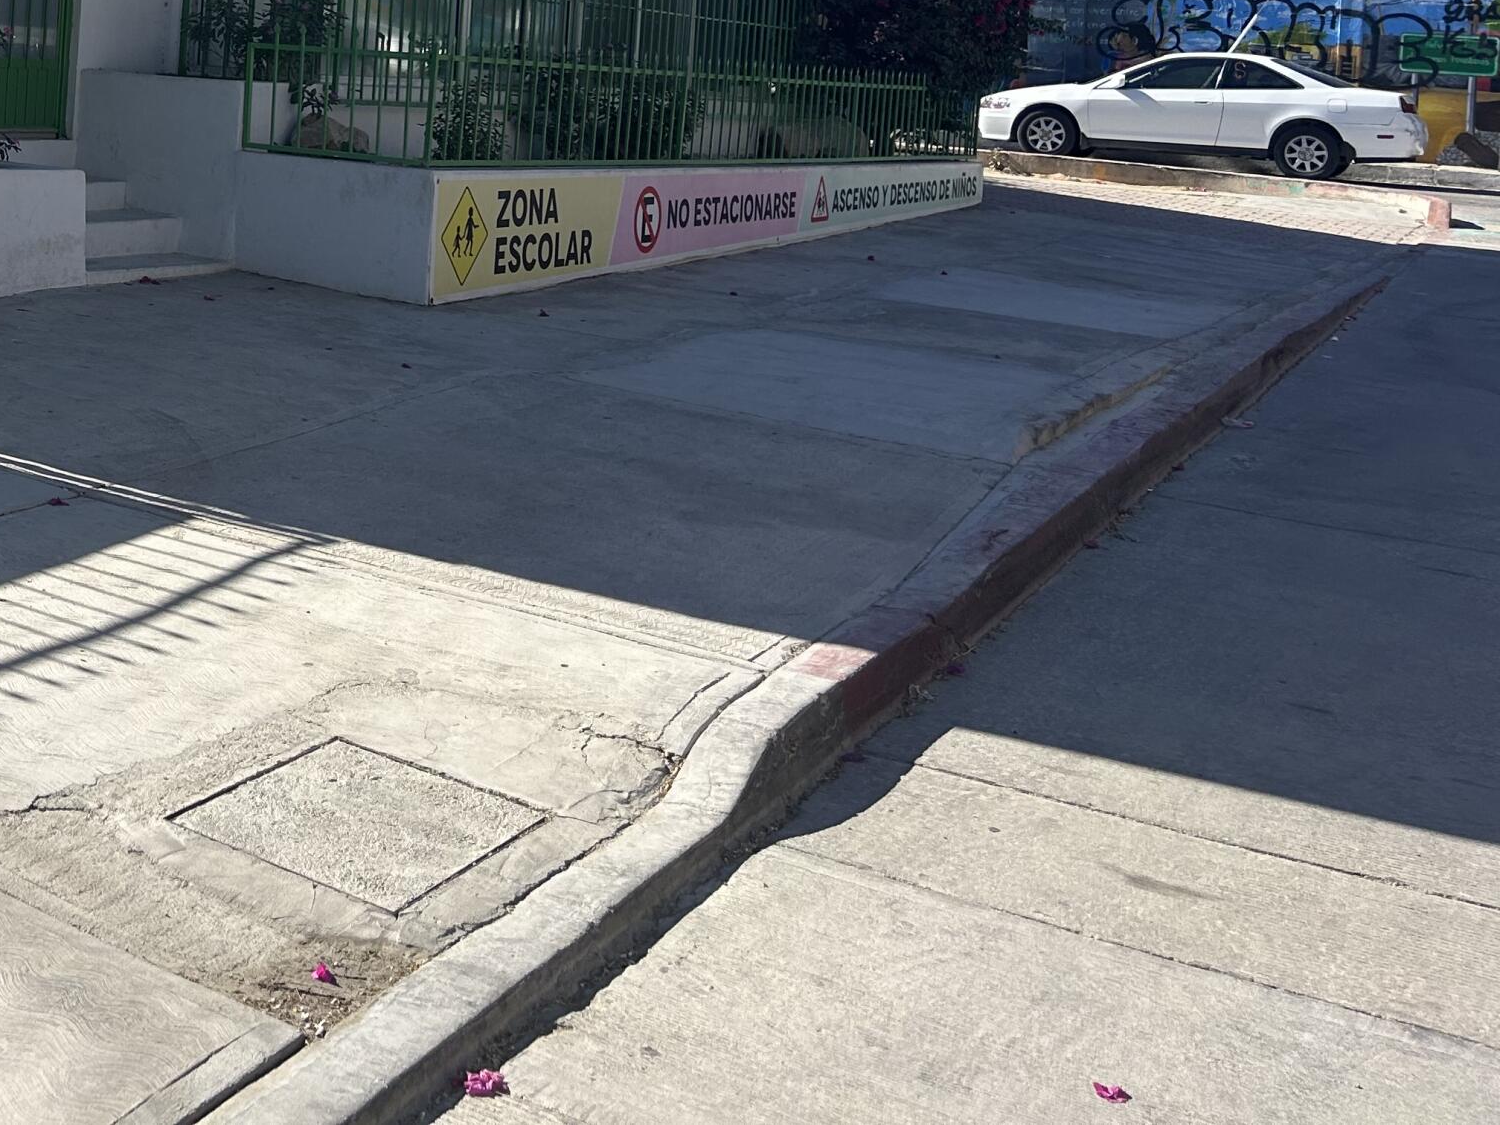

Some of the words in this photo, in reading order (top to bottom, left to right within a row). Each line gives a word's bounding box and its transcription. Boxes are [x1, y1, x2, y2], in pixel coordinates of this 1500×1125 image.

[496, 188, 559, 228] ZONA
[667, 198, 690, 229] NO
[693, 191, 797, 227] ESTACIONARSE
[832, 185, 880, 213] ASCENSO
[881, 184, 889, 206] Y
[890, 179, 937, 206] DESCENSO
[938, 178, 950, 199] DE
[951, 172, 977, 198] NIÑOS
[641, 196, 655, 243] E
[494, 229, 592, 275] ESCOLAR
